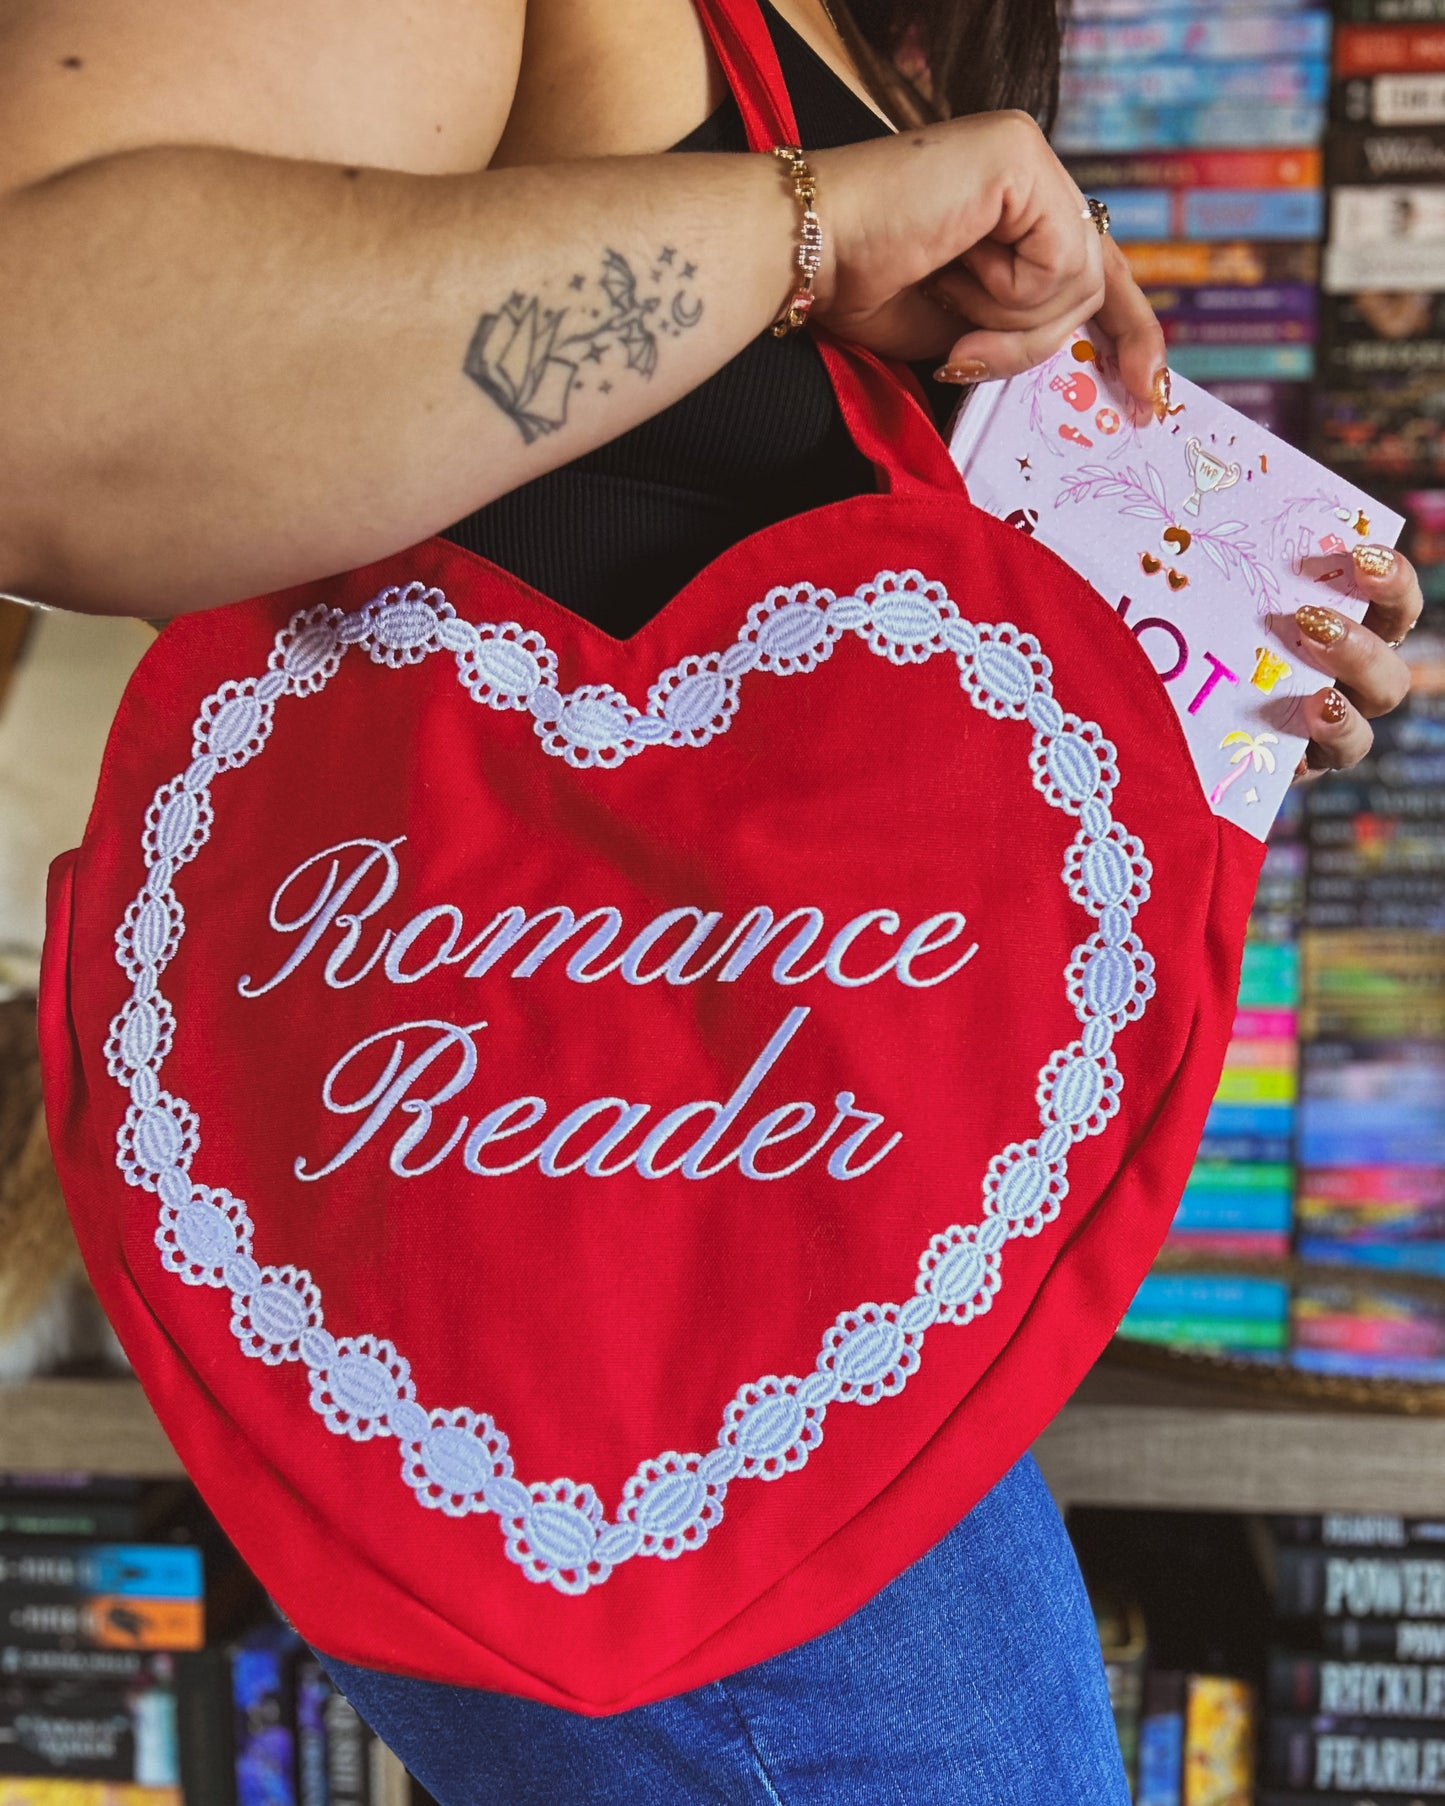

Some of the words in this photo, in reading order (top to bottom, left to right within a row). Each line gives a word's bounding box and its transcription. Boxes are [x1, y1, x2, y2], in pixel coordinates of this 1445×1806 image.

[1199, 461, 1219, 480] MVP
[1116, 594, 1240, 717] OT
[238, 835, 979, 998] Romance
[294, 1006, 903, 1181] Reader
